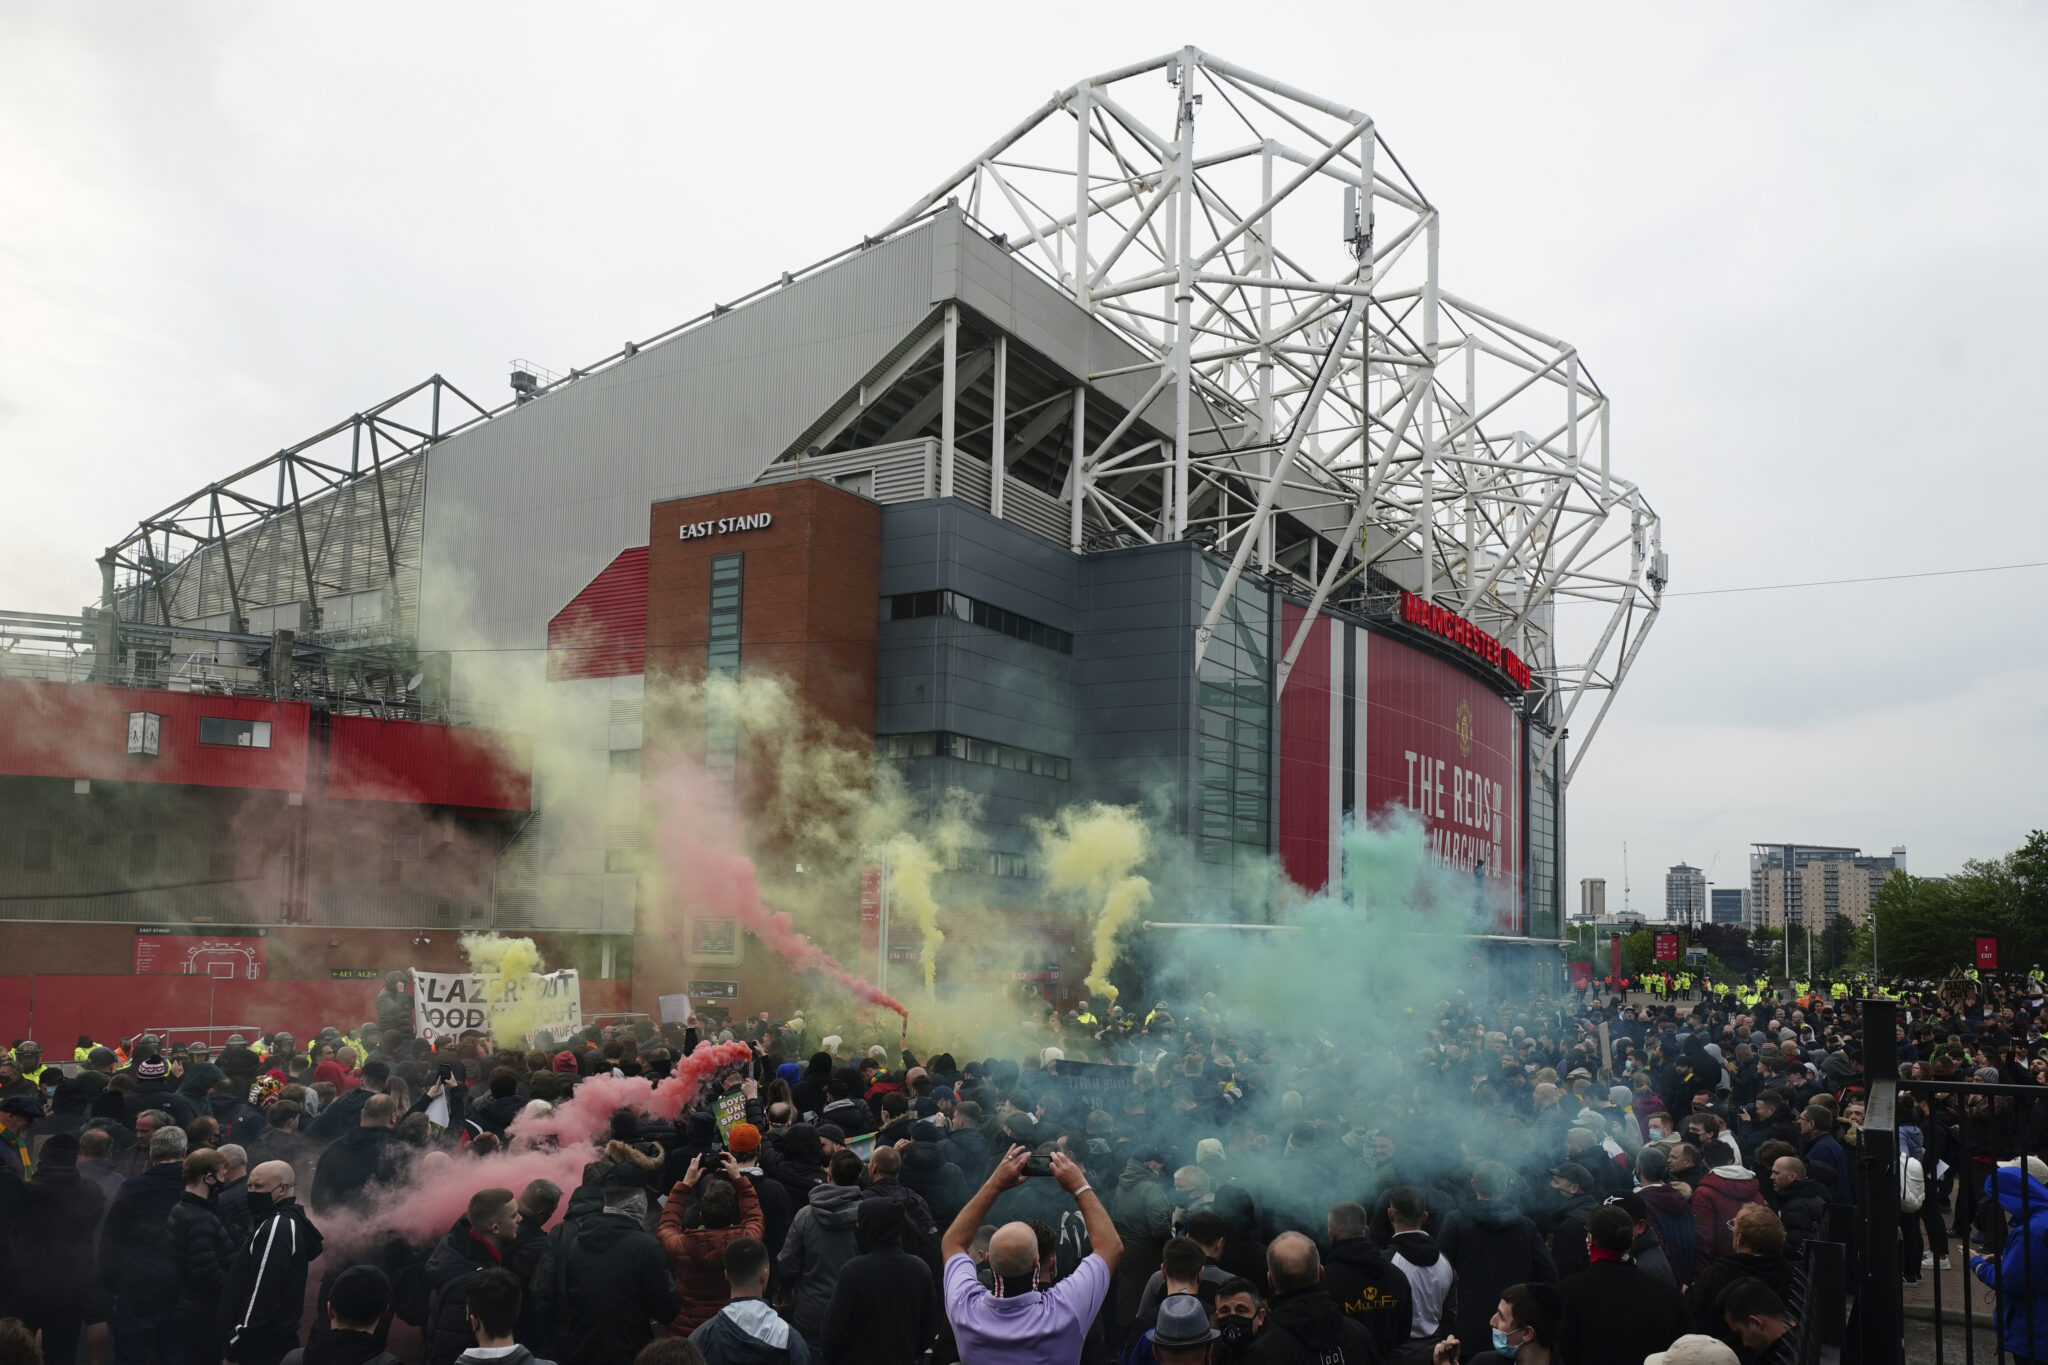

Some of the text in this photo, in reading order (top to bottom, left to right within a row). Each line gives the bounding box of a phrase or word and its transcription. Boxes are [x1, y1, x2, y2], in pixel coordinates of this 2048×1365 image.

[680, 512, 771, 540] EAST STAND
[1401, 592, 1500, 667] MANCHESTER
[1404, 750, 1491, 831] THE REDS
[1431, 827, 1491, 877] MARCHING
[1951, 991, 1967, 999] OUT
[552, 1024, 579, 1039] MUFC
[720, 1094, 746, 1109] BOYC
[727, 1102, 746, 1115] UNI
[721, 1112, 746, 1125] SPON
